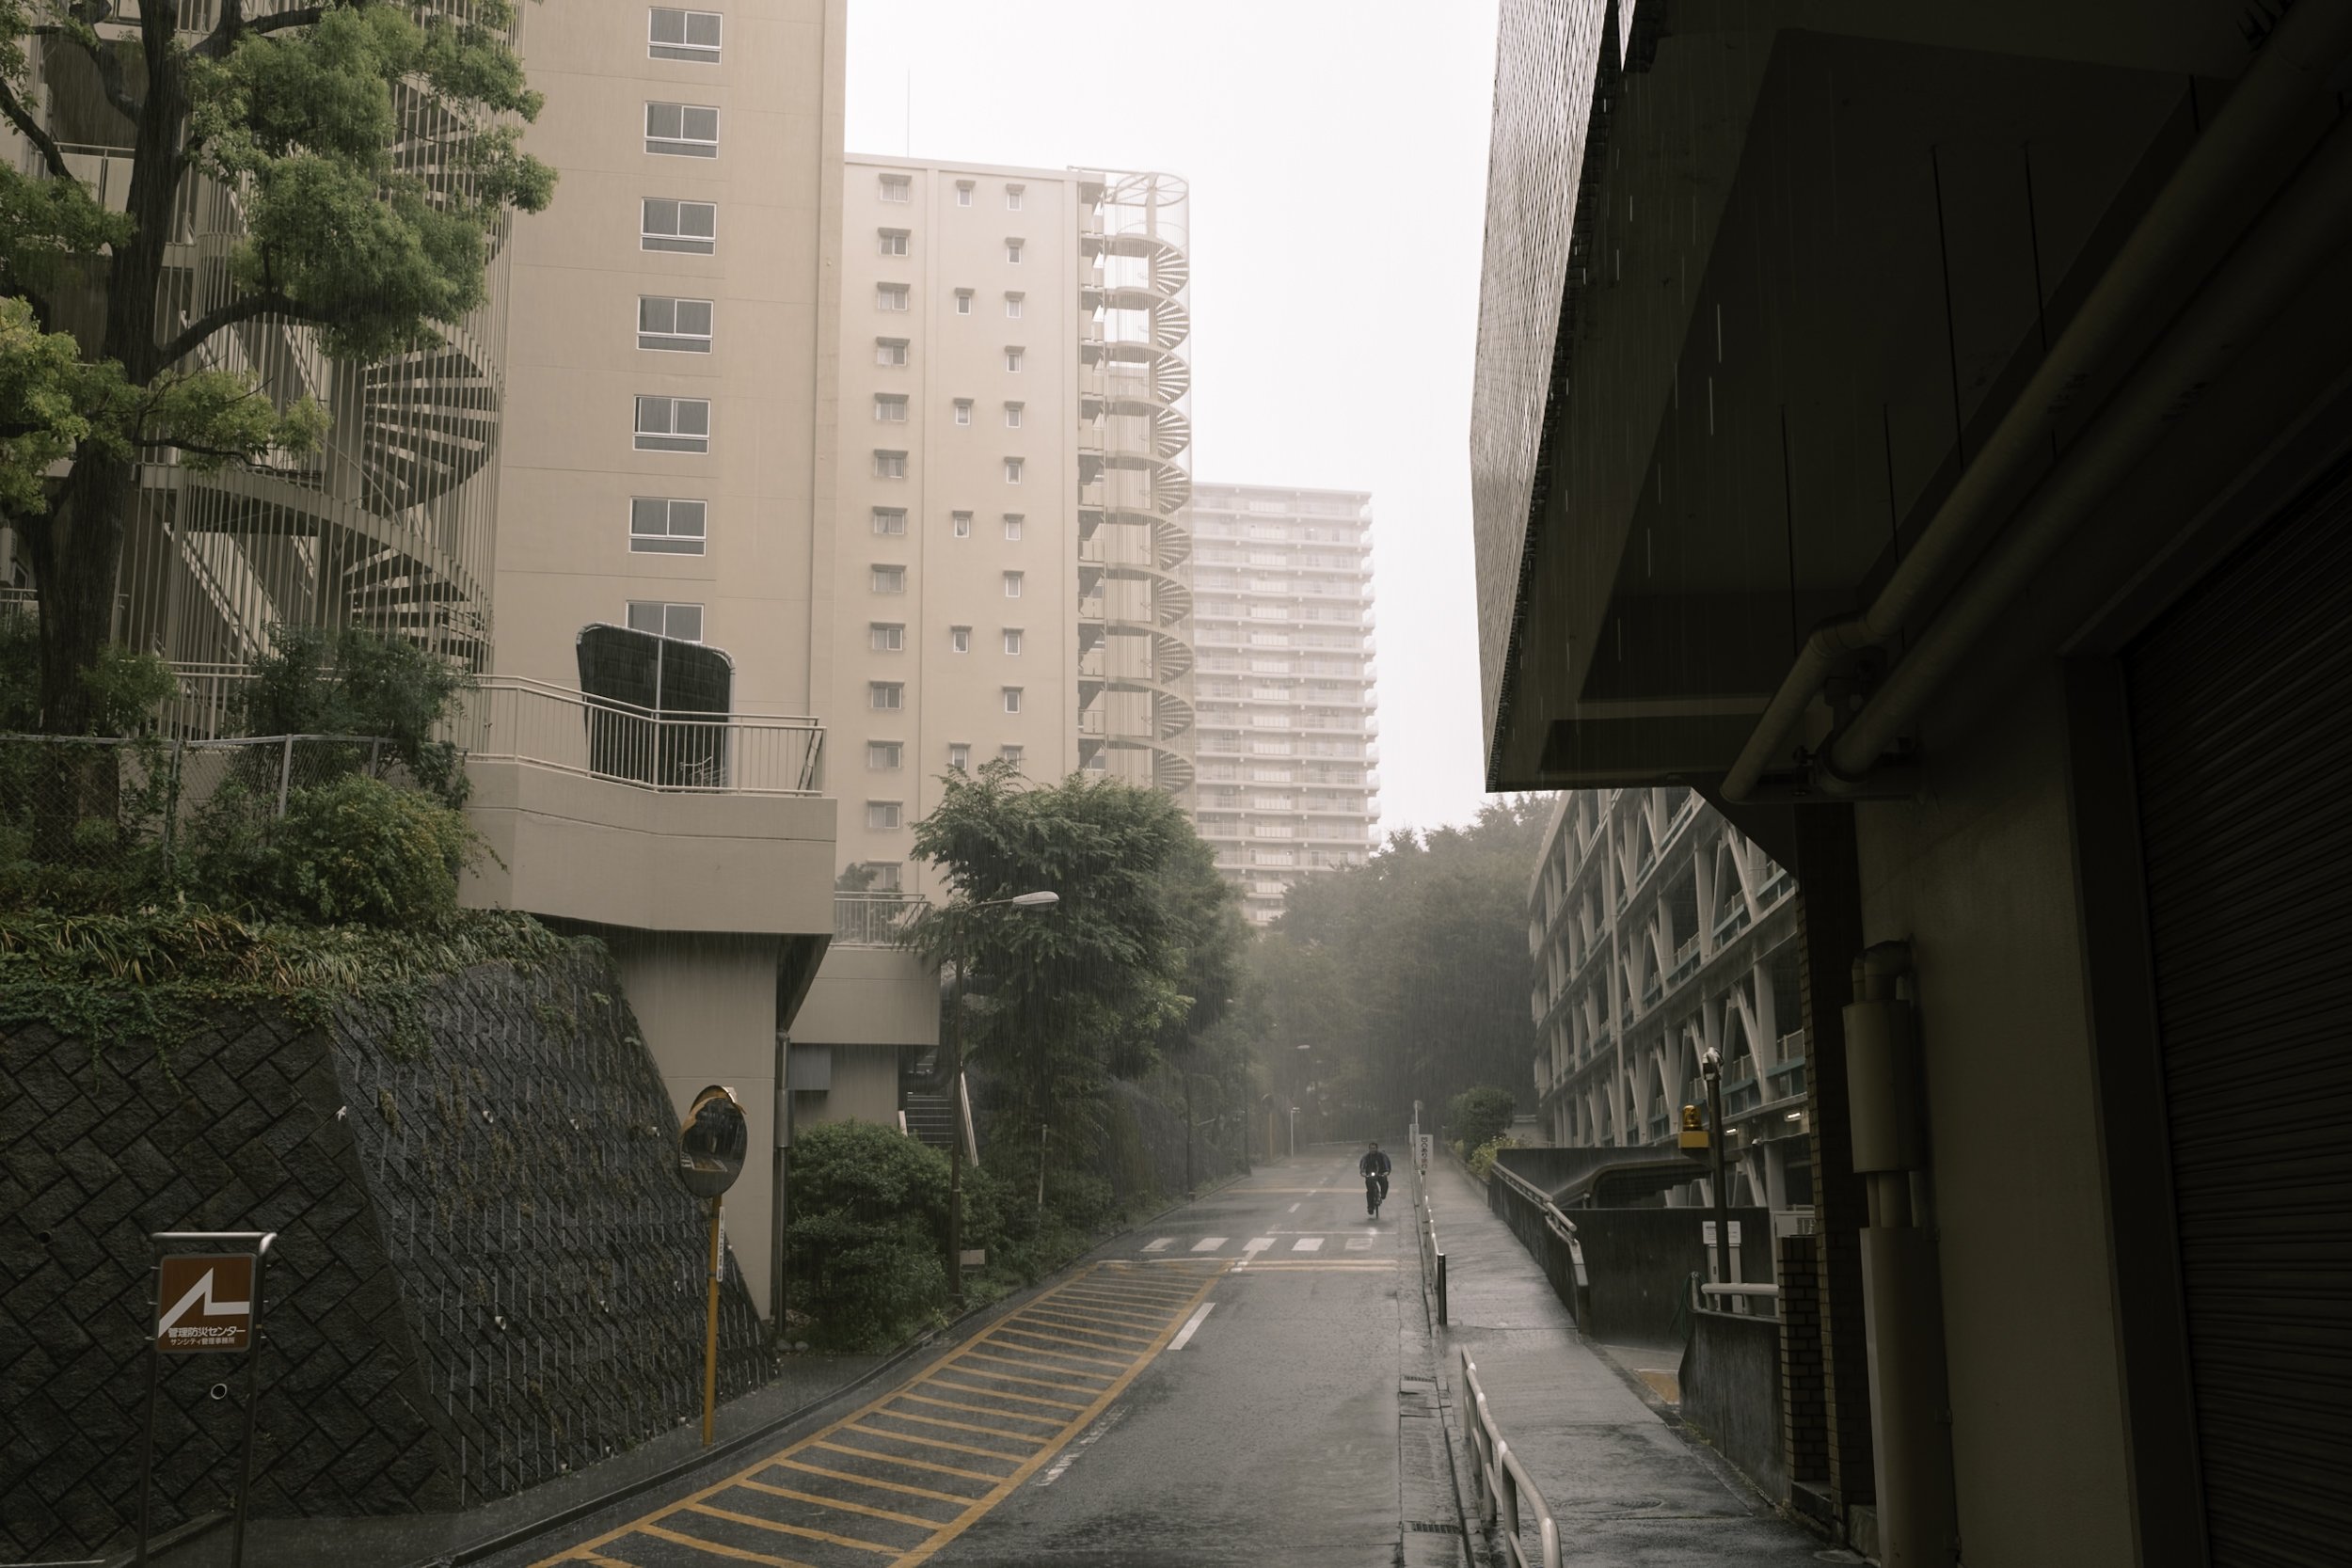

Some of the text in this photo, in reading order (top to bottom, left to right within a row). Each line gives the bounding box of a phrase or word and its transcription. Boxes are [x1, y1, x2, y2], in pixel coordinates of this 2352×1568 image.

[168, 1326, 246, 1338] 管理防災センター
